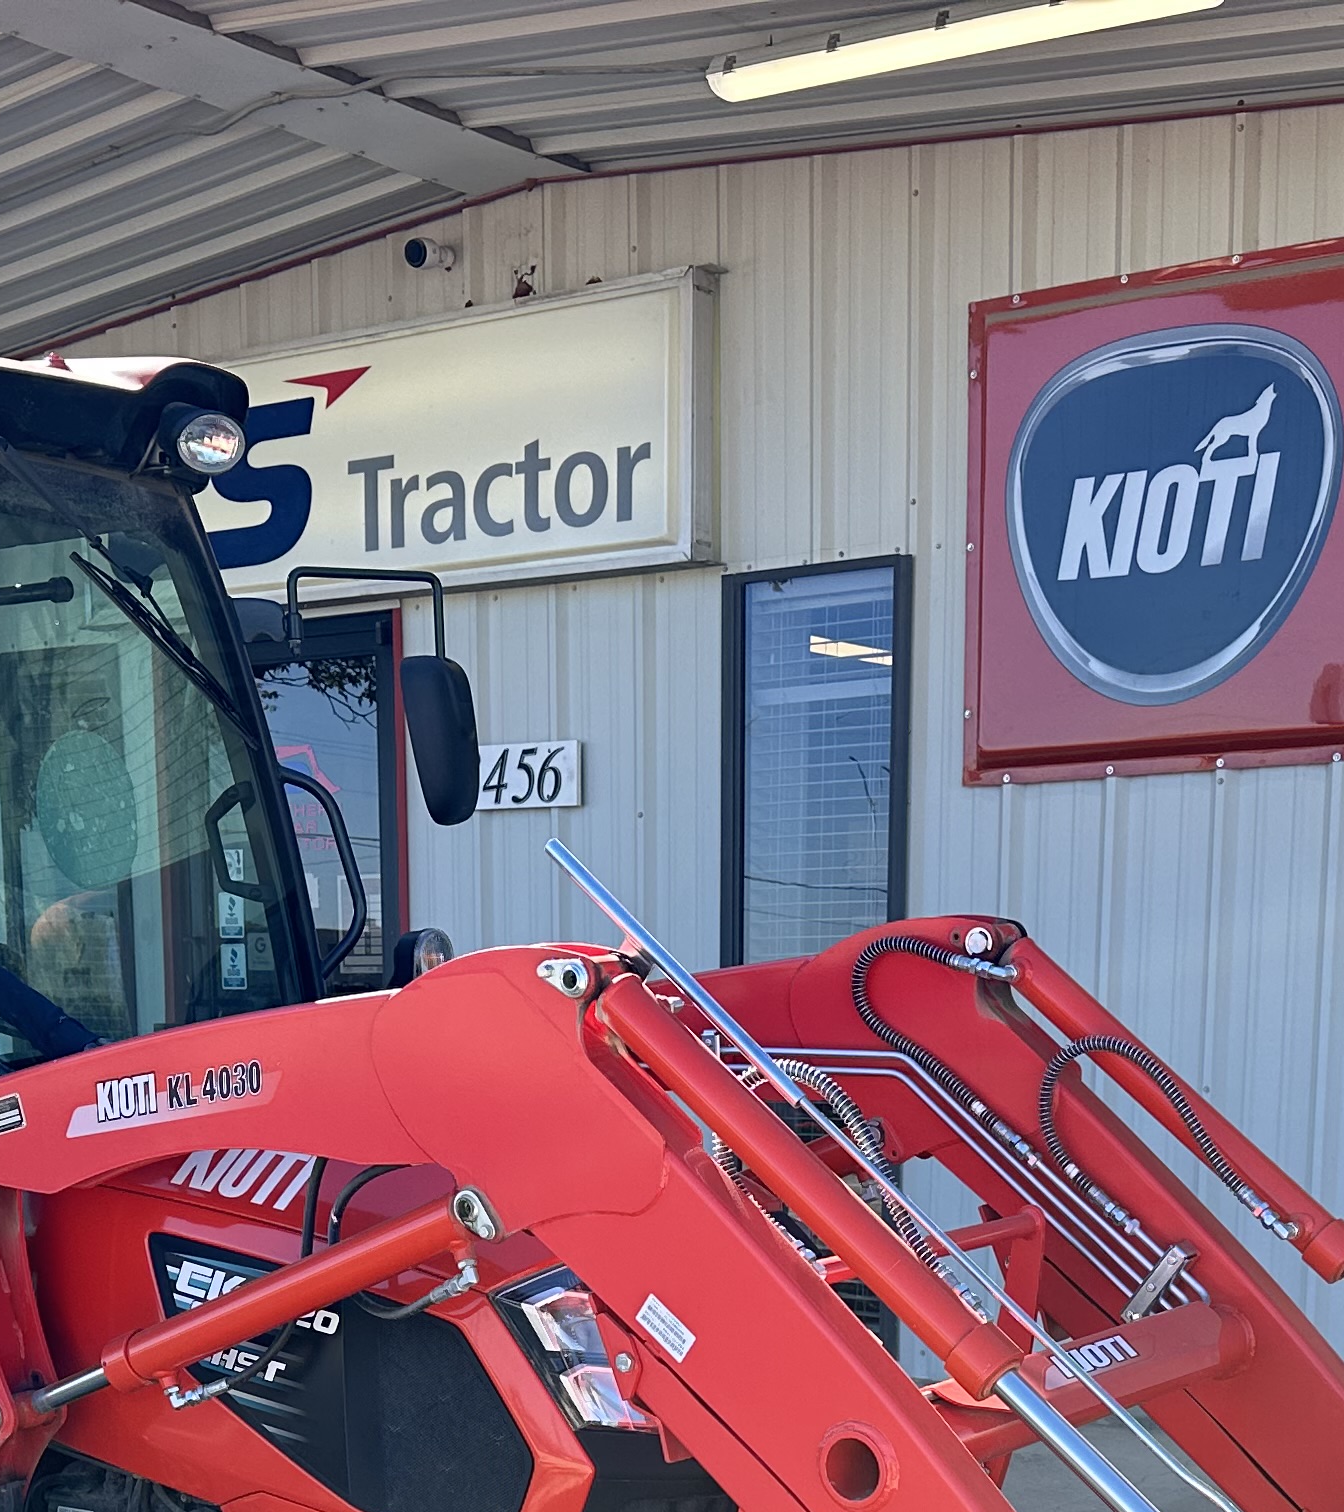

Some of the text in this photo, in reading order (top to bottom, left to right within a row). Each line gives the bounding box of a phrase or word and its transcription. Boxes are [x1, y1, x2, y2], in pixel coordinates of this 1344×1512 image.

[348, 438, 651, 552] Tractor
[1056, 451, 1281, 581] KIOTI
[482, 746, 565, 805] 456
[96, 1059, 263, 1123] KIOTI KL 4030
